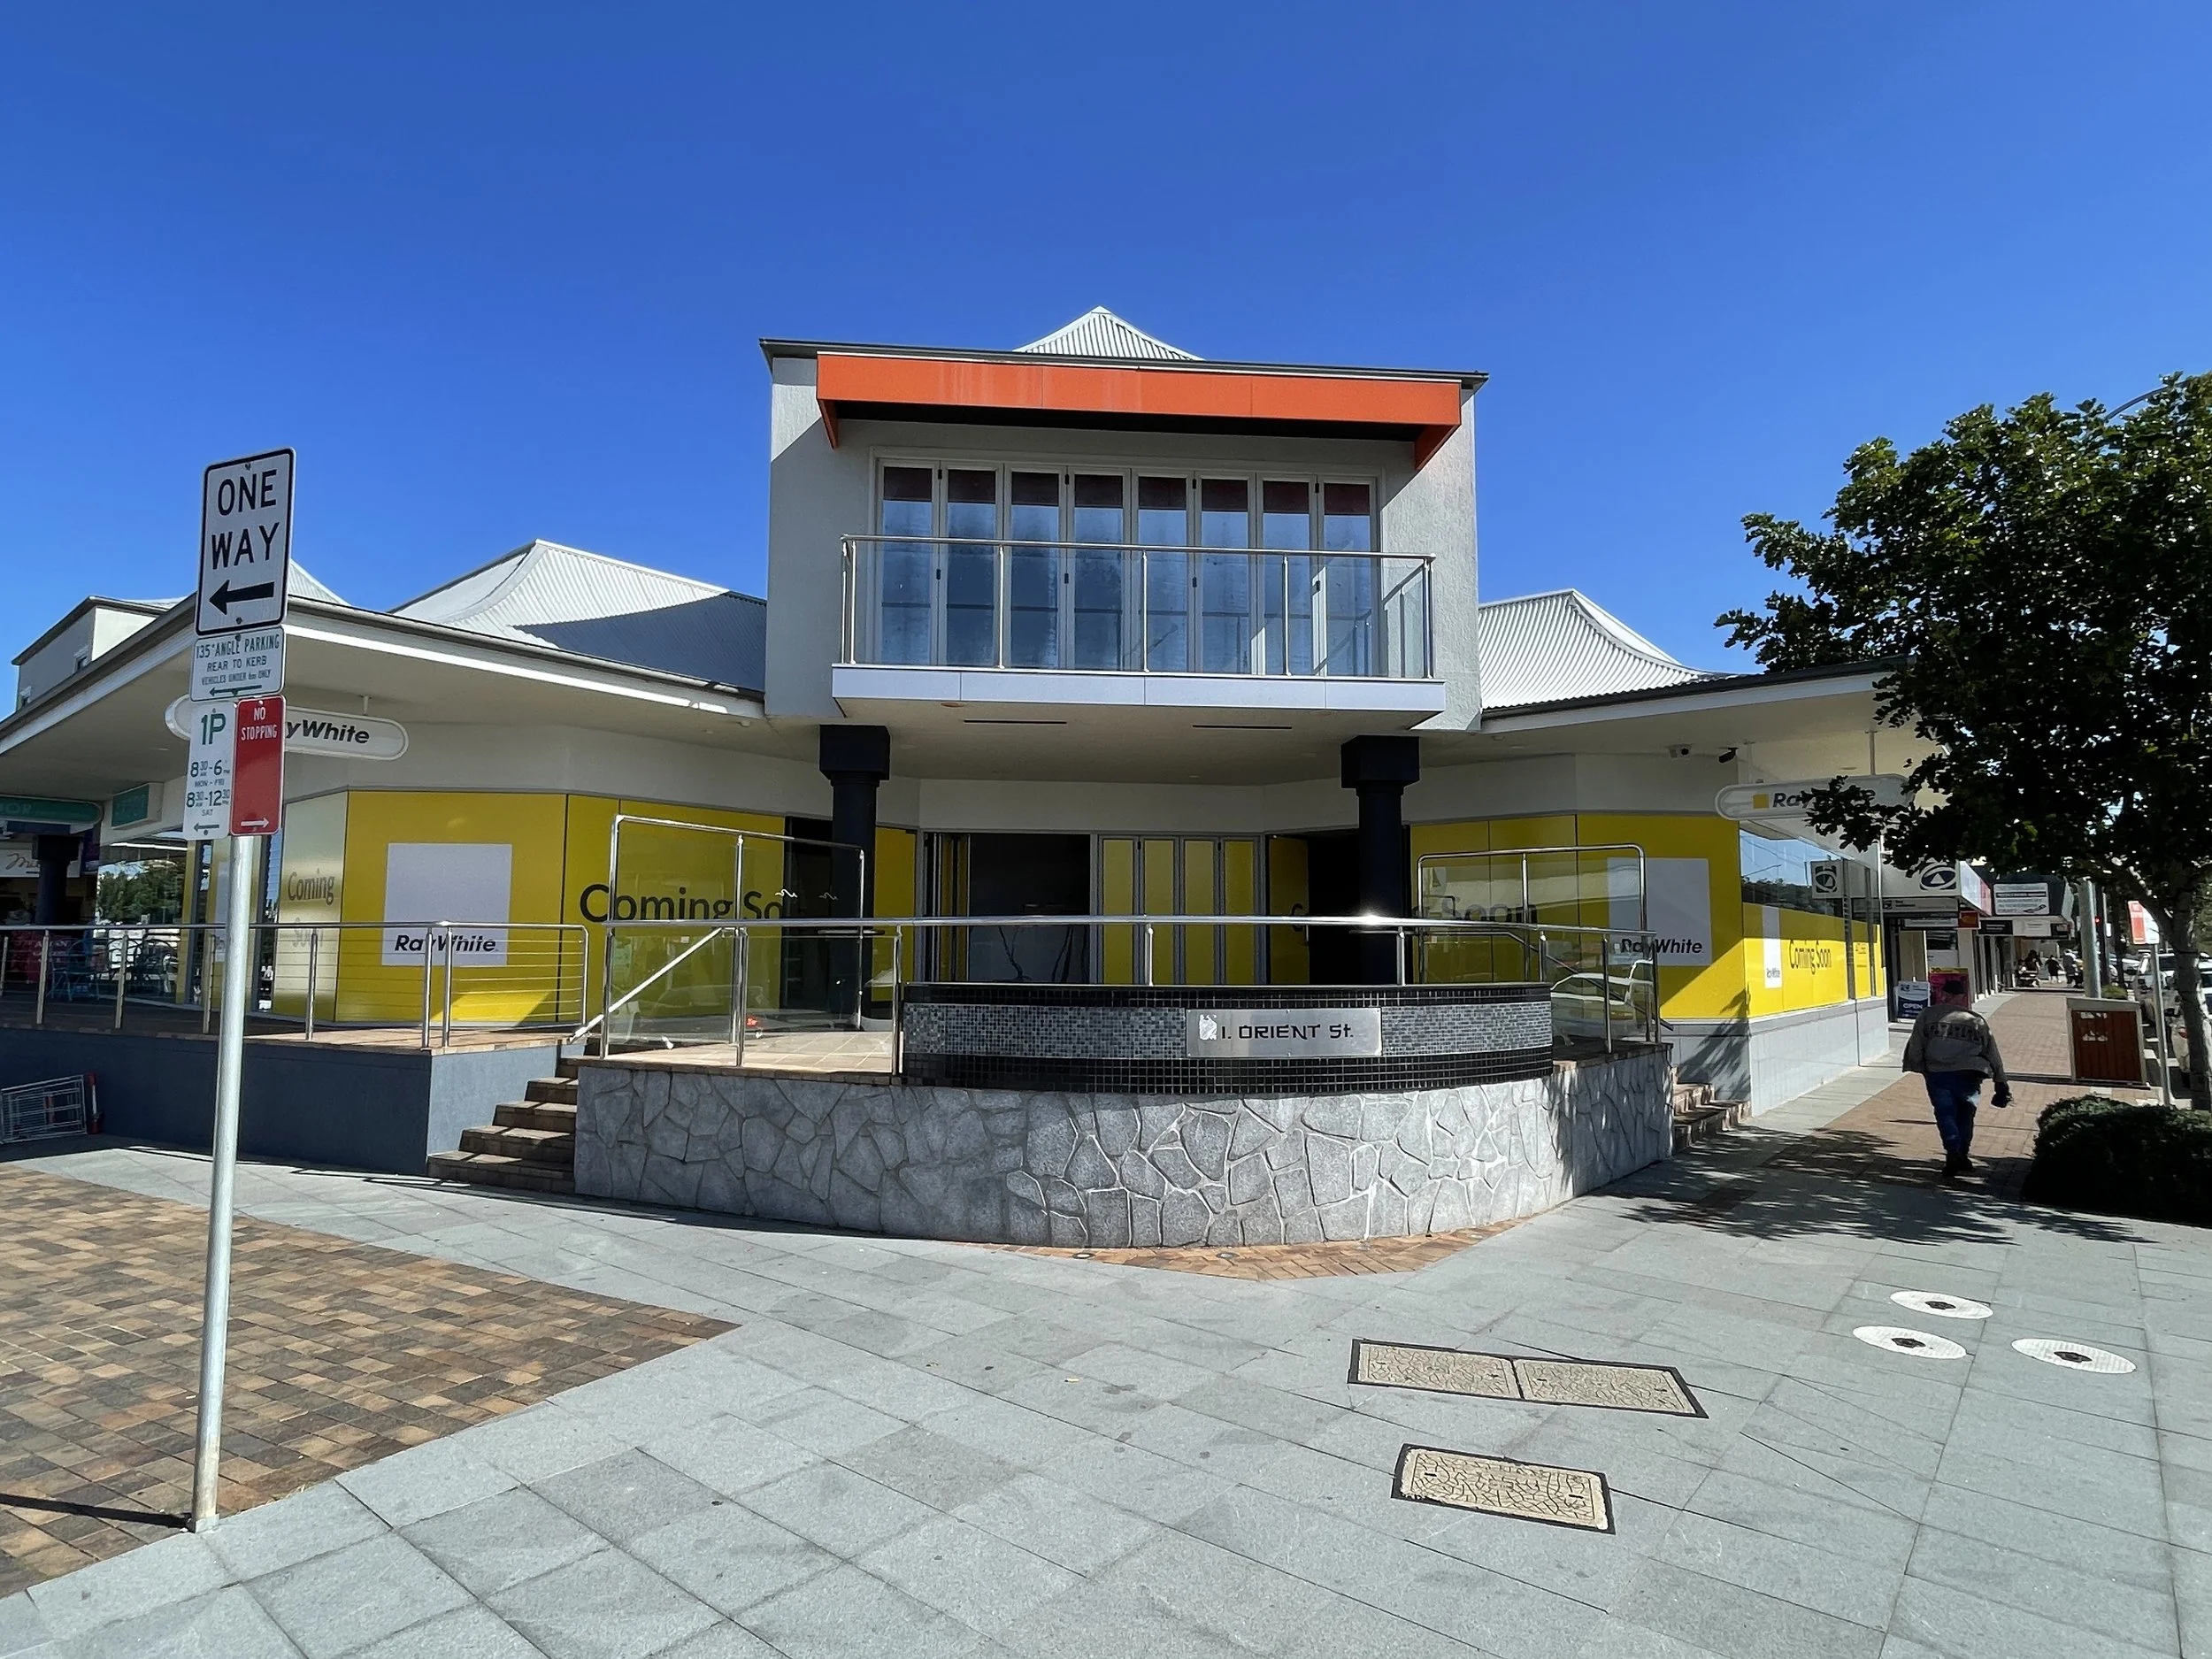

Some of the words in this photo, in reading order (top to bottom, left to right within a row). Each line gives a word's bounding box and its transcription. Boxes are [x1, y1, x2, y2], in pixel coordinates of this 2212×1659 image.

[218, 469, 277, 516] ONE
[211, 522, 280, 570] WAY
[244, 634, 280, 652] PARKING
[207, 660, 229, 672] REAR
[233, 658, 242, 669] TO
[246, 655, 267, 668] KERB
[253, 707, 266, 721] NO
[201, 713, 227, 745] 1P
[241, 725, 278, 741] STOPPING
[288, 868, 335, 906] Coming
[580, 883, 734, 922] Coming
[1239, 1024, 1321, 1041] ORIENT
